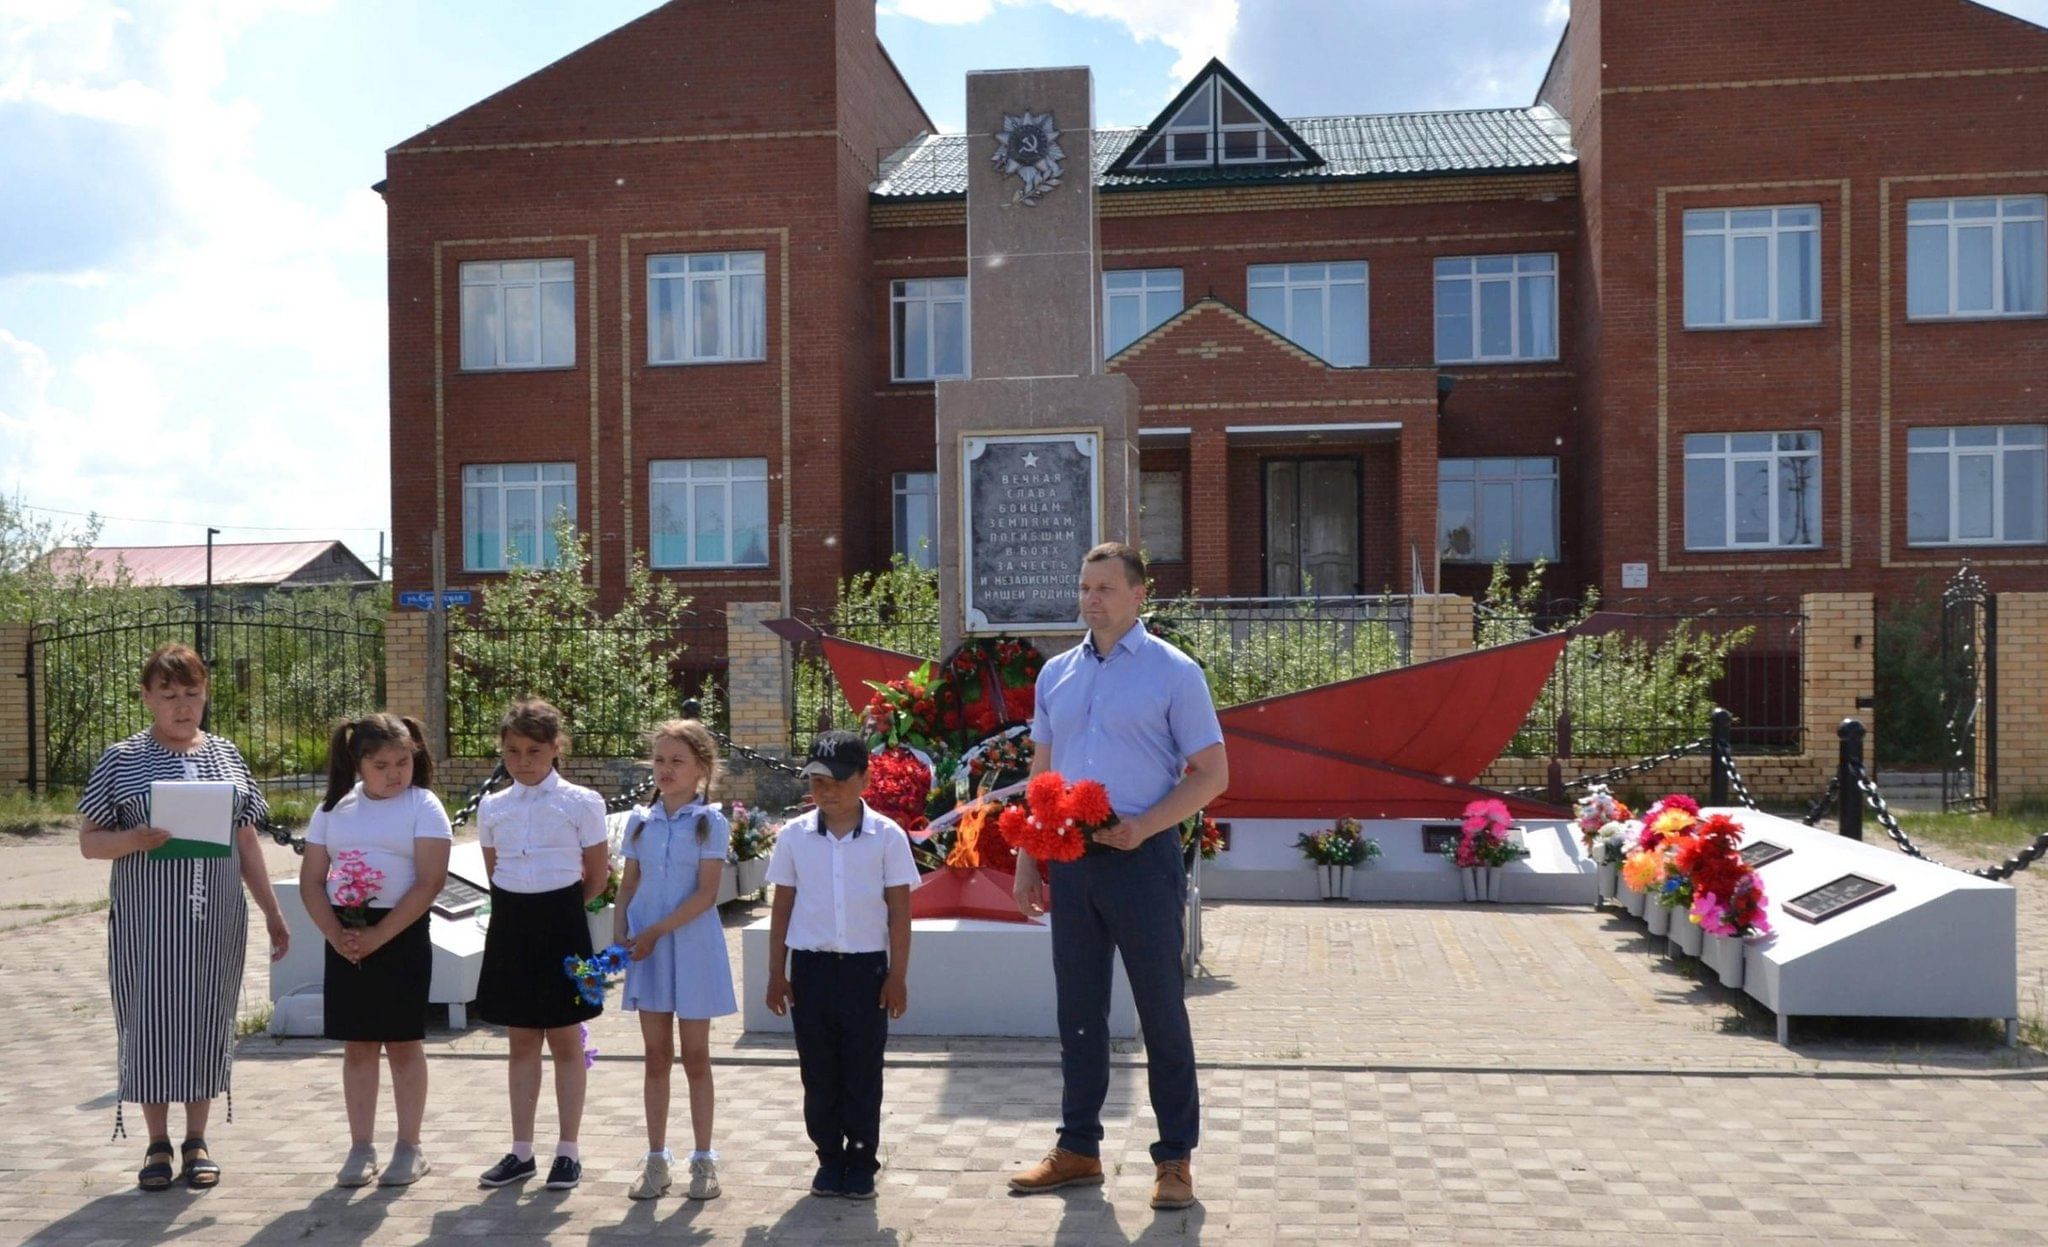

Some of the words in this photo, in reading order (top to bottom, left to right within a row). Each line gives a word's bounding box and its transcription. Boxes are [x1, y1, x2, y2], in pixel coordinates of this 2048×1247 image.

[1002, 473, 1061, 484] ВЕЧНАЯ
[990, 531, 1075, 542] ПОГИБШИМ
[1005, 547, 1013, 556] В
[1020, 546, 1060, 556] БОЯХ
[997, 561, 1014, 571] ЗА
[1020, 560, 1069, 570] ЧЕСТЬ
[980, 576, 988, 586] И
[994, 574, 1078, 586] НЕЗАВИСИМОСТ
